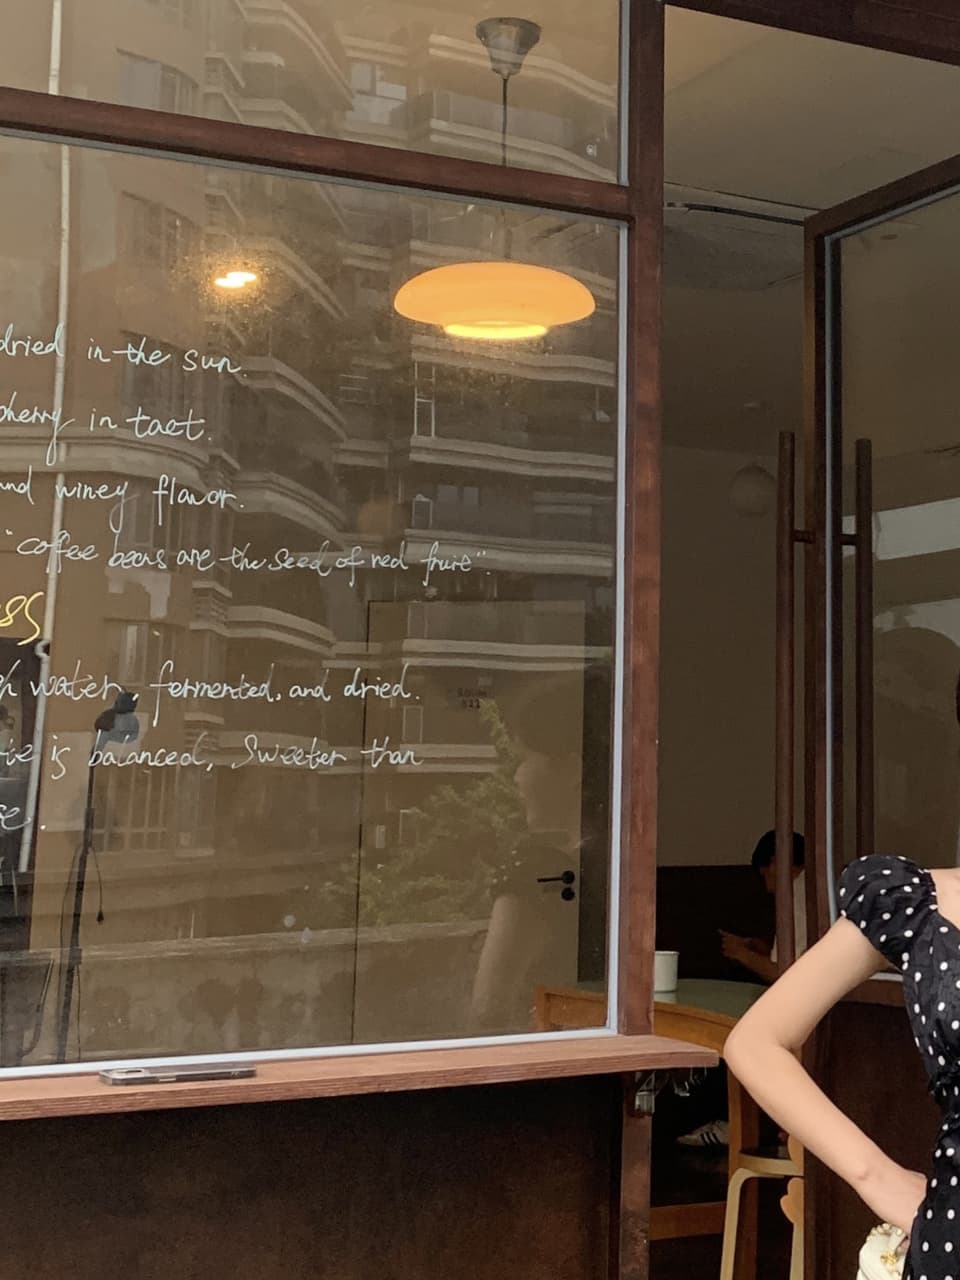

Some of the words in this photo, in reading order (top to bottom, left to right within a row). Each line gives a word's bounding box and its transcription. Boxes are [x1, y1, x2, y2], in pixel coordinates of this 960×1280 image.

[0, 322, 65, 357] dried
[86, 338, 111, 362] in
[112, 337, 171, 365] the
[182, 349, 247, 377] sun.
[89, 408, 118, 431] in
[0, 465, 34, 505] nd
[55, 481, 140, 533] winey
[176, 549, 216, 571] are
[219, 543, 268, 571] the
[335, 546, 365, 587] of
[370, 541, 409, 570] red
[289, 668, 331, 701] and
[343, 662, 420, 700] dried.
[51, 735, 71, 780] is
[360, 736, 424, 768] than
